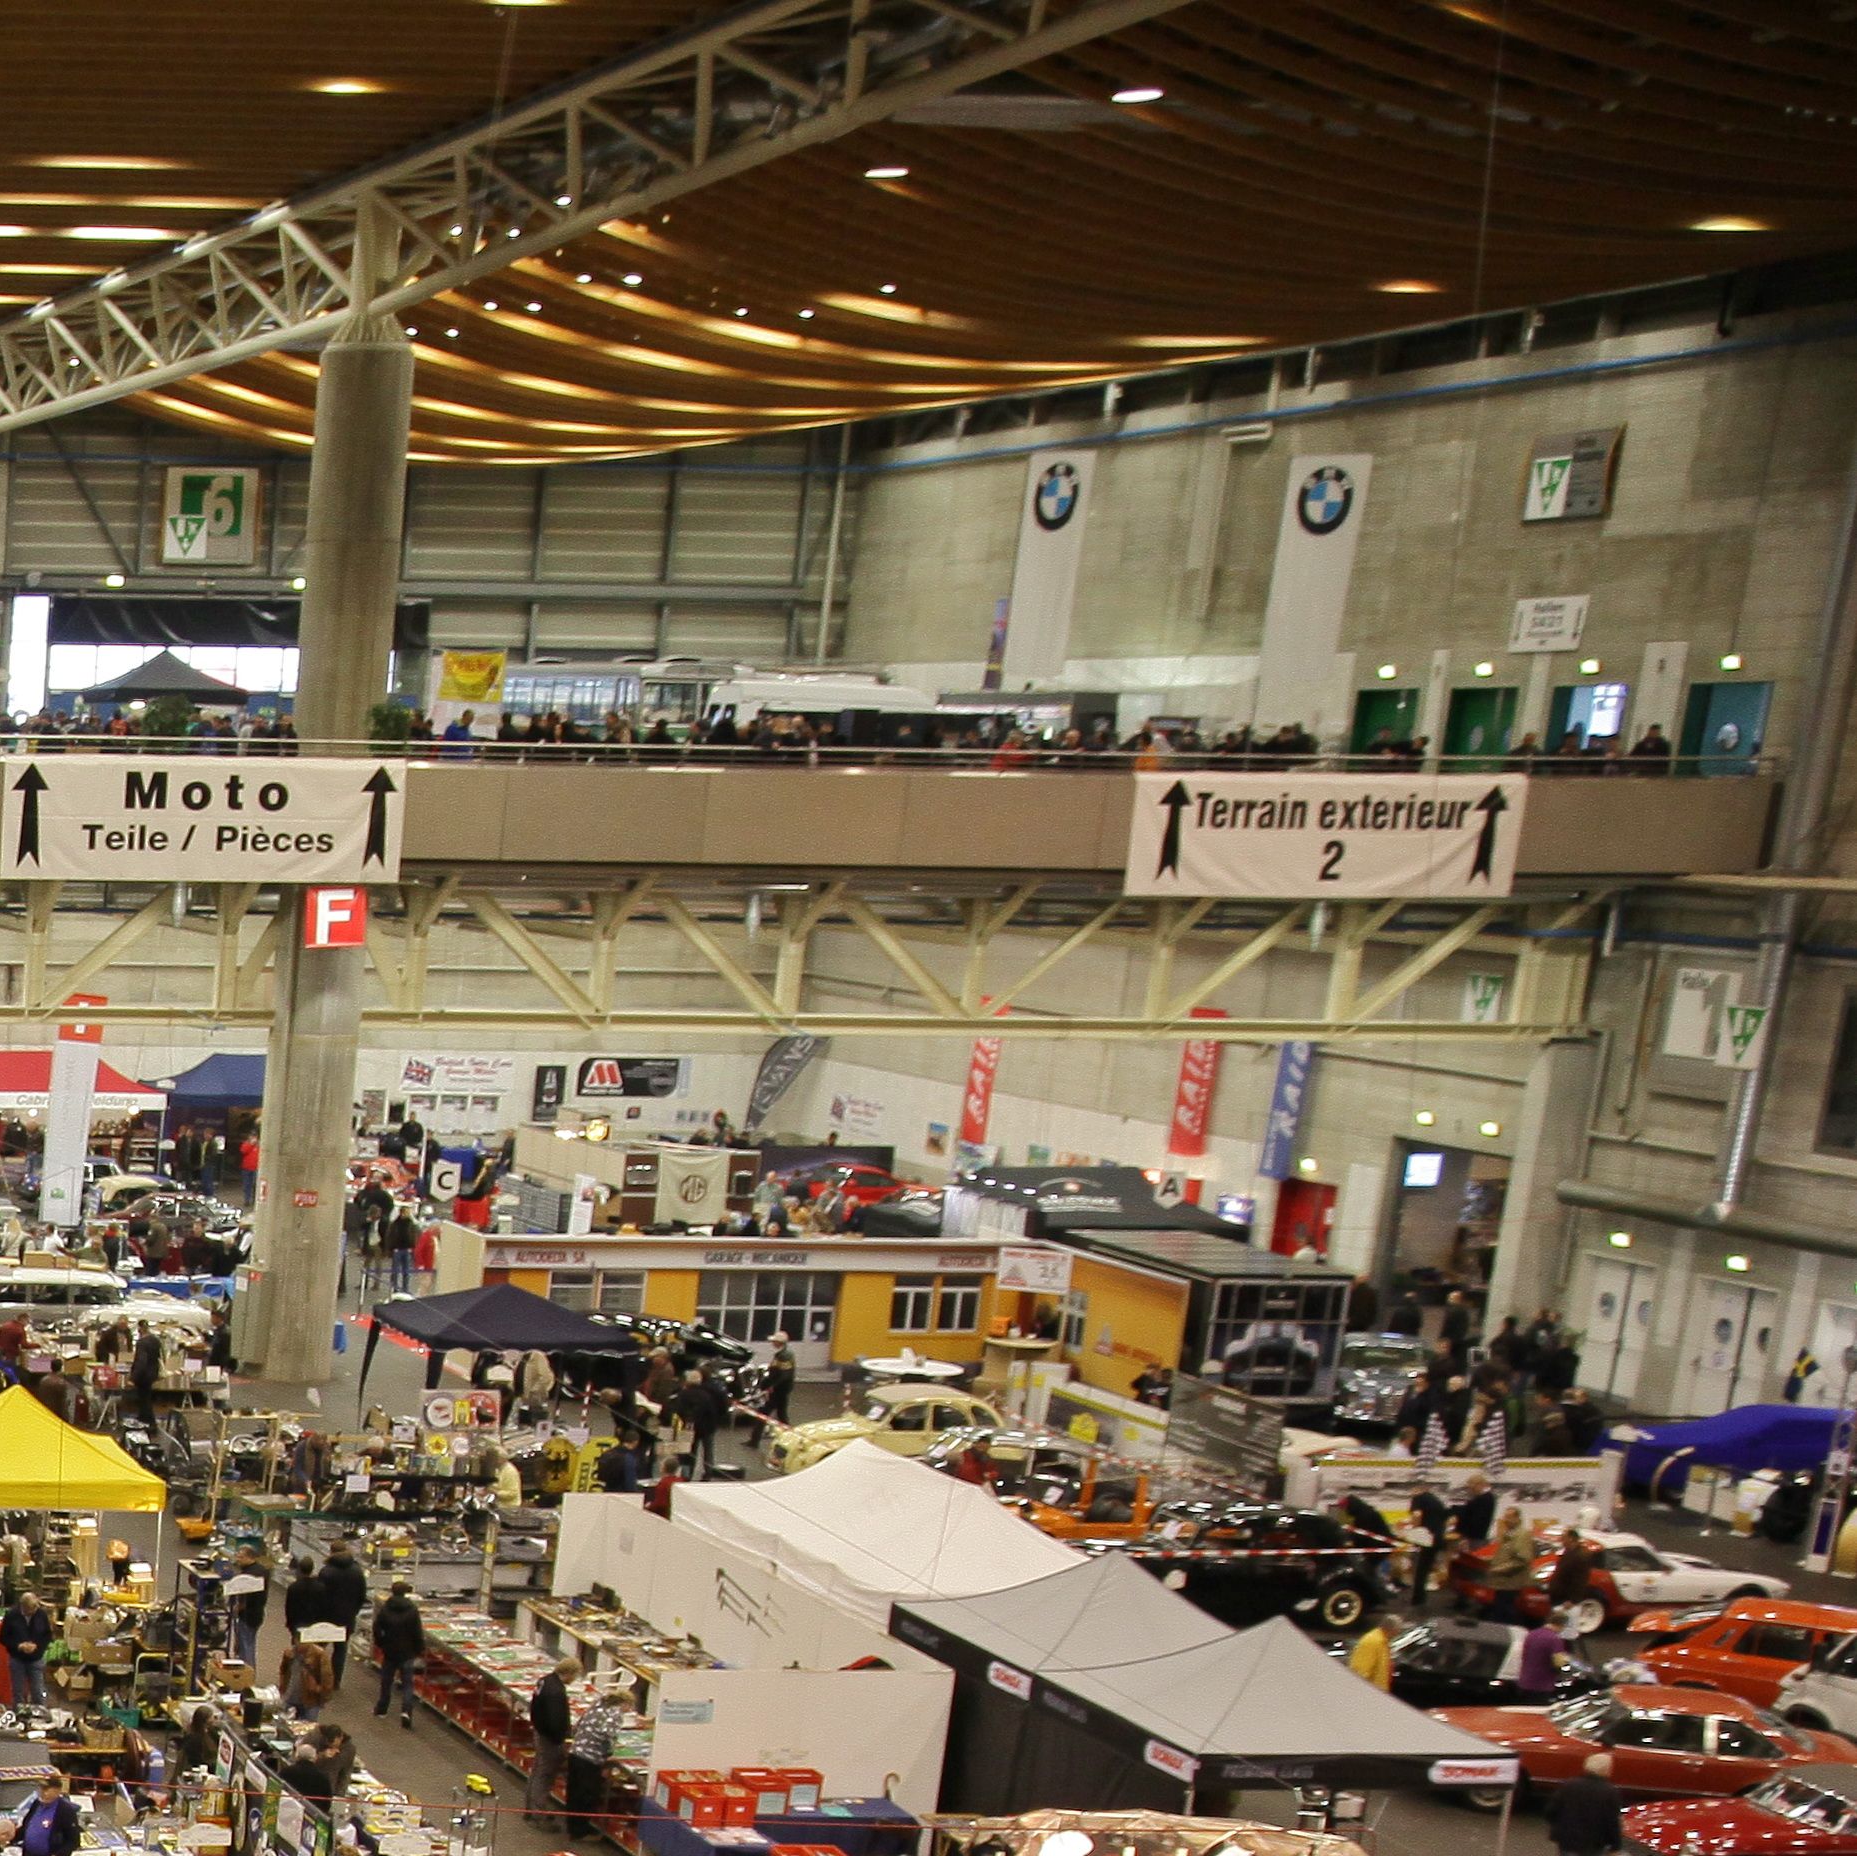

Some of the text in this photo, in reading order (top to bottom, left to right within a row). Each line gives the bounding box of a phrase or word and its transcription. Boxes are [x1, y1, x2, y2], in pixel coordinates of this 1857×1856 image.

[205, 478, 236, 537] 6
[124, 771, 290, 810] Moto
[1195, 791, 1309, 831] Terrain
[82, 824, 336, 853] Teile Pièces
[1319, 840, 1344, 882] 2
[315, 889, 354, 944] F
[436, 1171, 452, 1189] C
[1161, 1178, 1177, 1195] A
